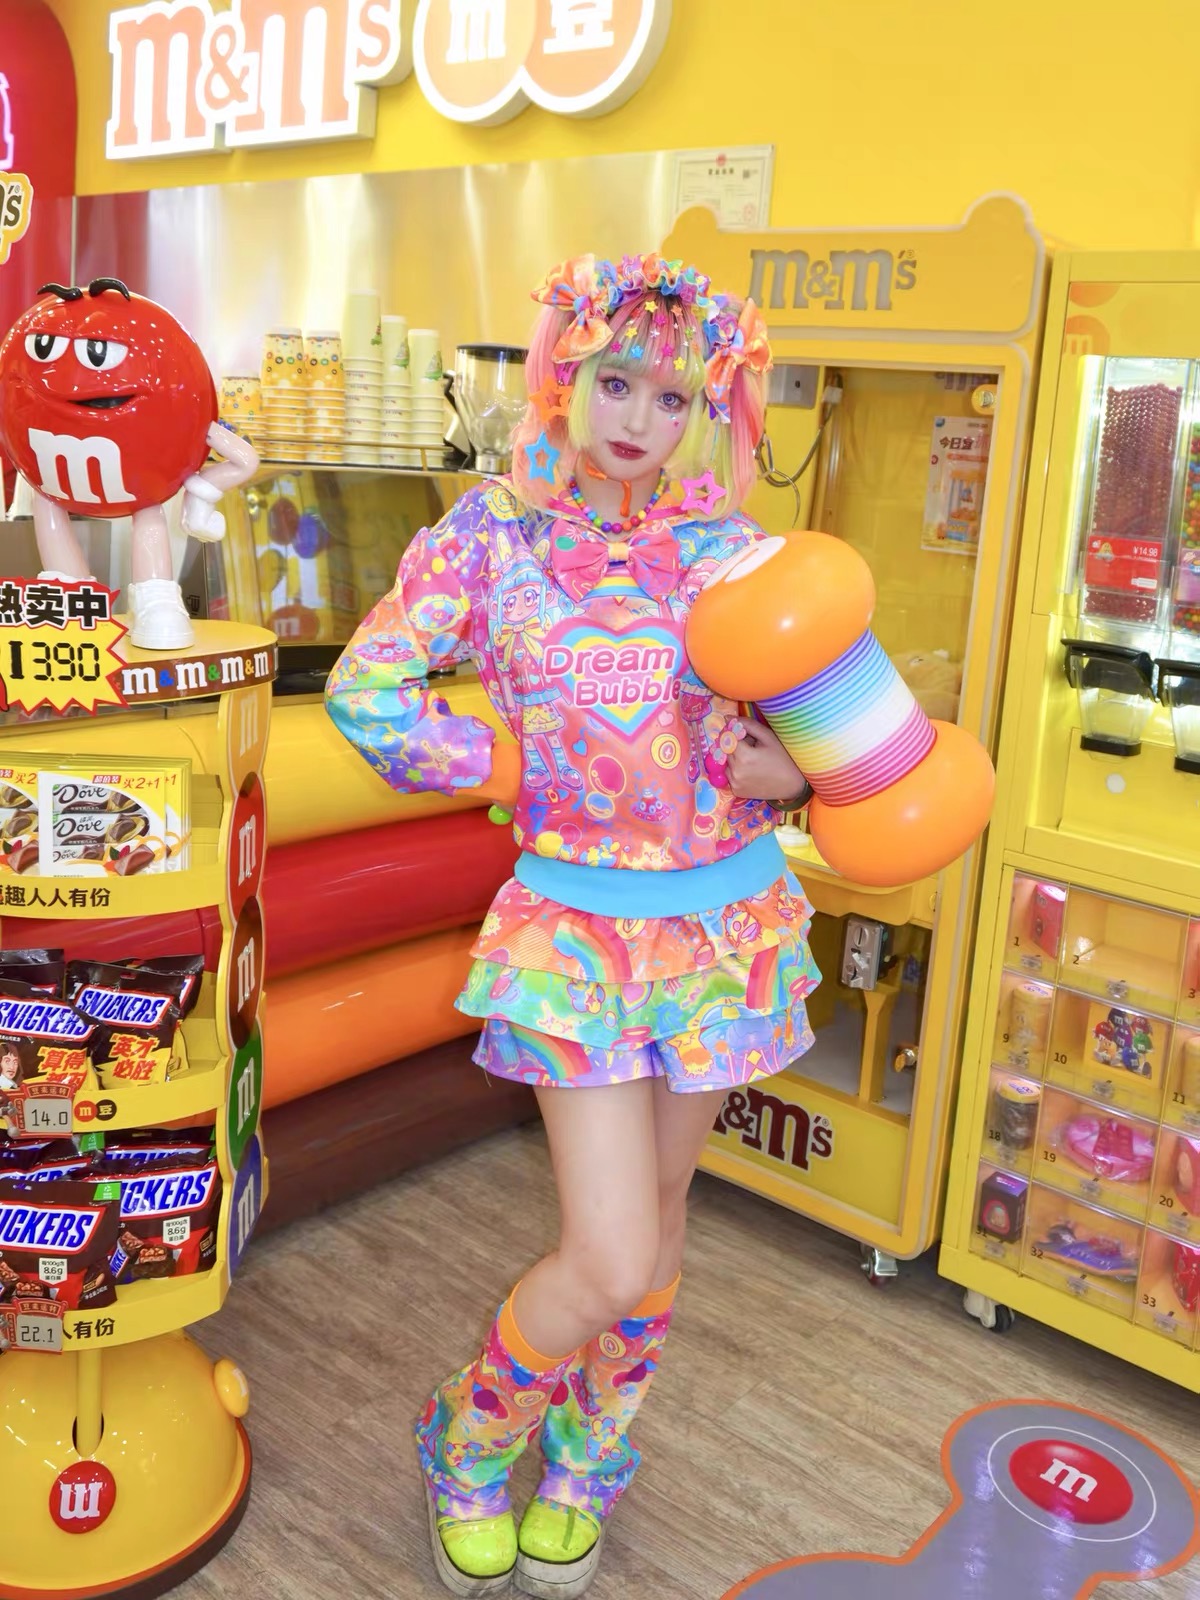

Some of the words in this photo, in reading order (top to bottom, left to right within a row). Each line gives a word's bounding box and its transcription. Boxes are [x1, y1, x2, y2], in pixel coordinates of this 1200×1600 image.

[28, 428, 137, 504] m
[544, 647, 676, 676] Dream
[574, 677, 681, 707] Bubble
[53, 784, 107, 804] Dove
[53, 818, 105, 837] Dove
[0, 885, 110, 908] 趣人人有份
[78, 990, 166, 1023] SNICKERS
[1053, 1053, 1067, 1065] 10
[31, 1109, 68, 1127] 14.0
[712, 1087, 833, 1171] &m's
[1043, 1151, 1056, 1163] 19
[1159, 1195, 1173, 1208] 20
[43, 1266, 63, 1275] 8.6g
[20, 1325, 54, 1343] 22.1
[1039, 1457, 1098, 1502] m
